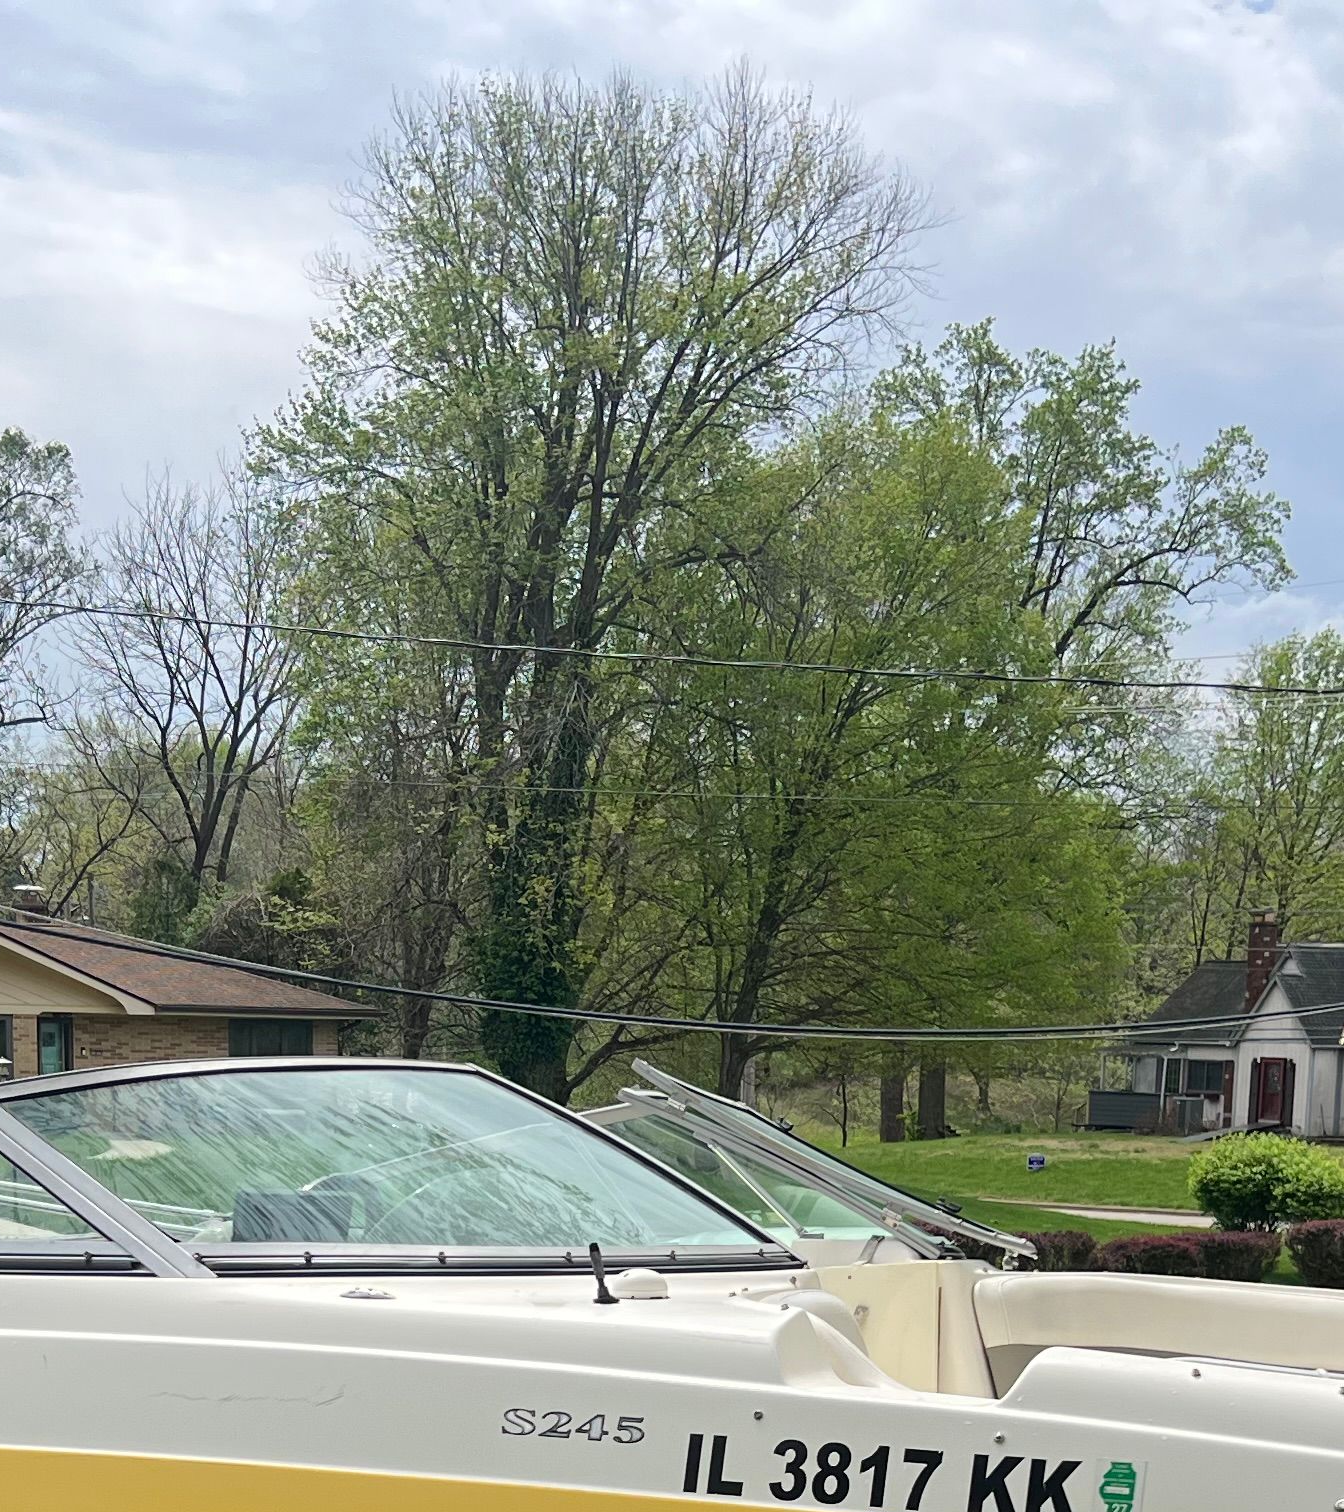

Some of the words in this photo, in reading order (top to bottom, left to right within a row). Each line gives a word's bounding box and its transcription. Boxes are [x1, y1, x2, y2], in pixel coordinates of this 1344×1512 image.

[501, 1408, 646, 1444] S245
[682, 1433, 744, 1497] IL
[768, 1439, 945, 1512] 3817
